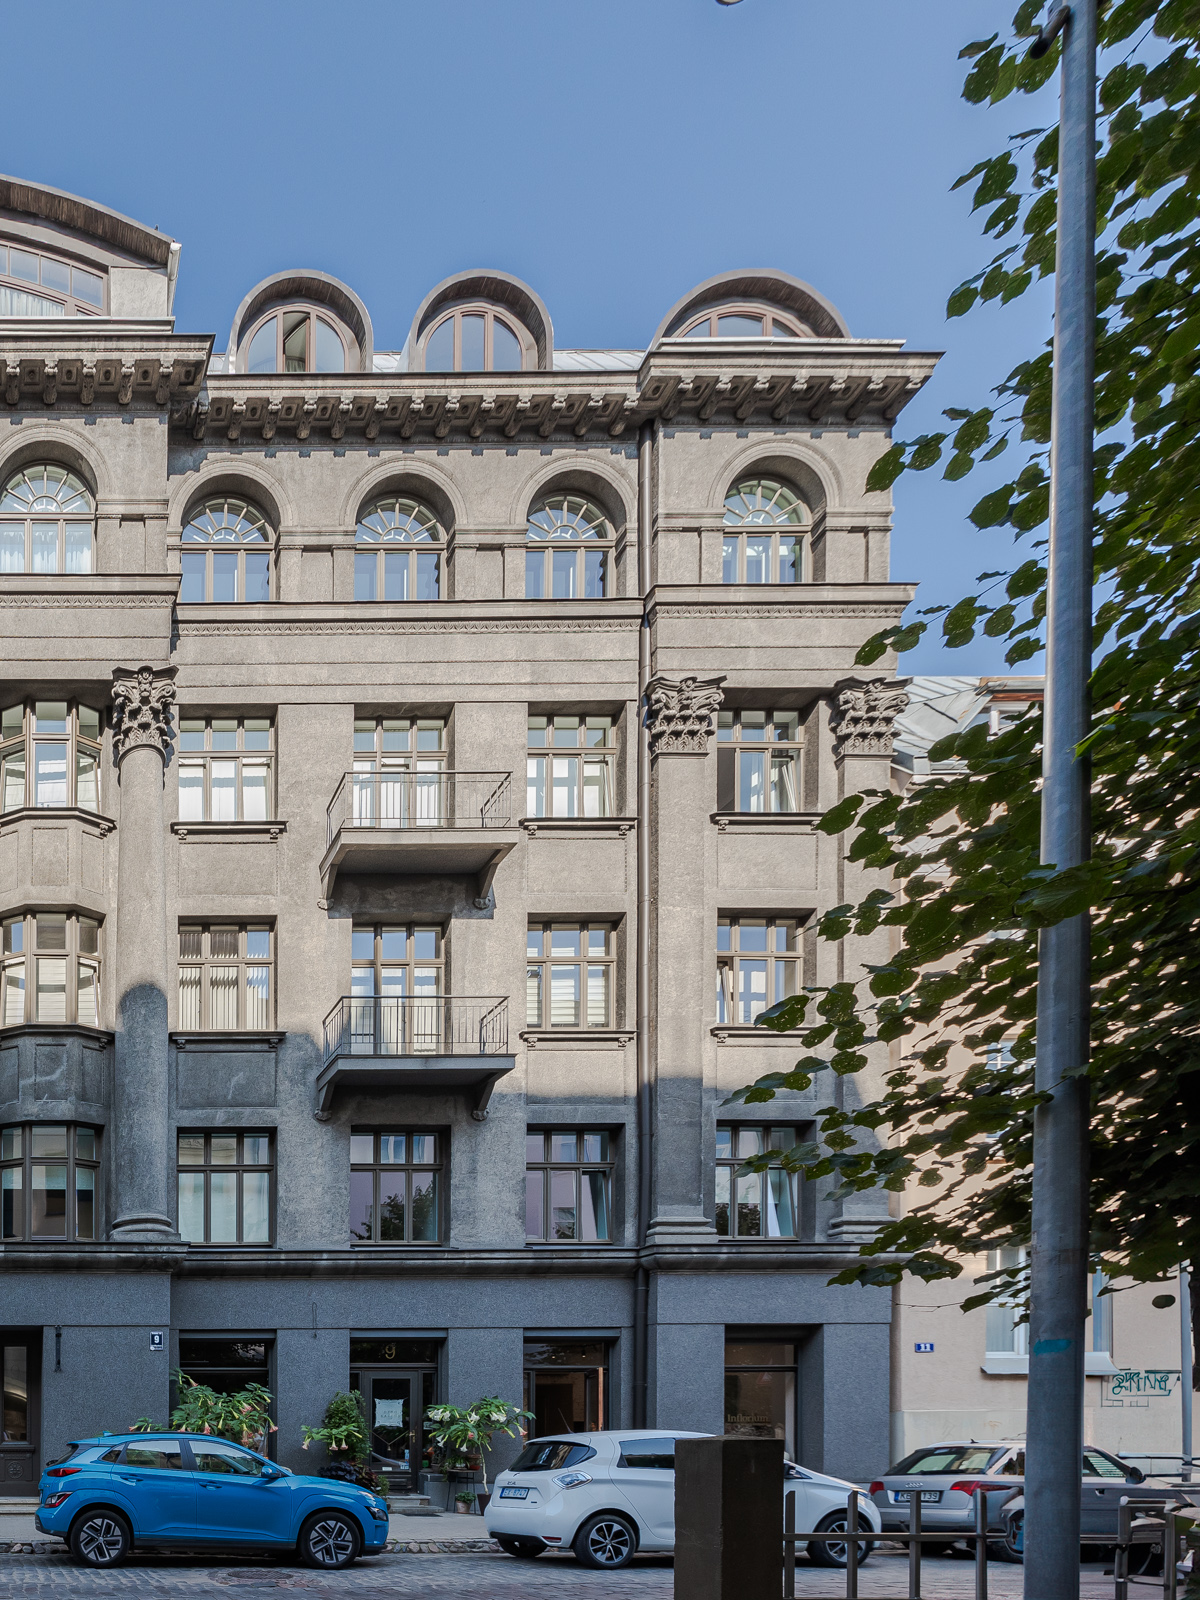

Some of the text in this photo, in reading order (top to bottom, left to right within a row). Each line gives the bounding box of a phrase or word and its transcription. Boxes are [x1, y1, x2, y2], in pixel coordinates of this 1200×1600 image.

[154, 1335, 160, 1344] 9
[920, 1343, 931, 1351] 11
[385, 1345, 396, 1360] 9
